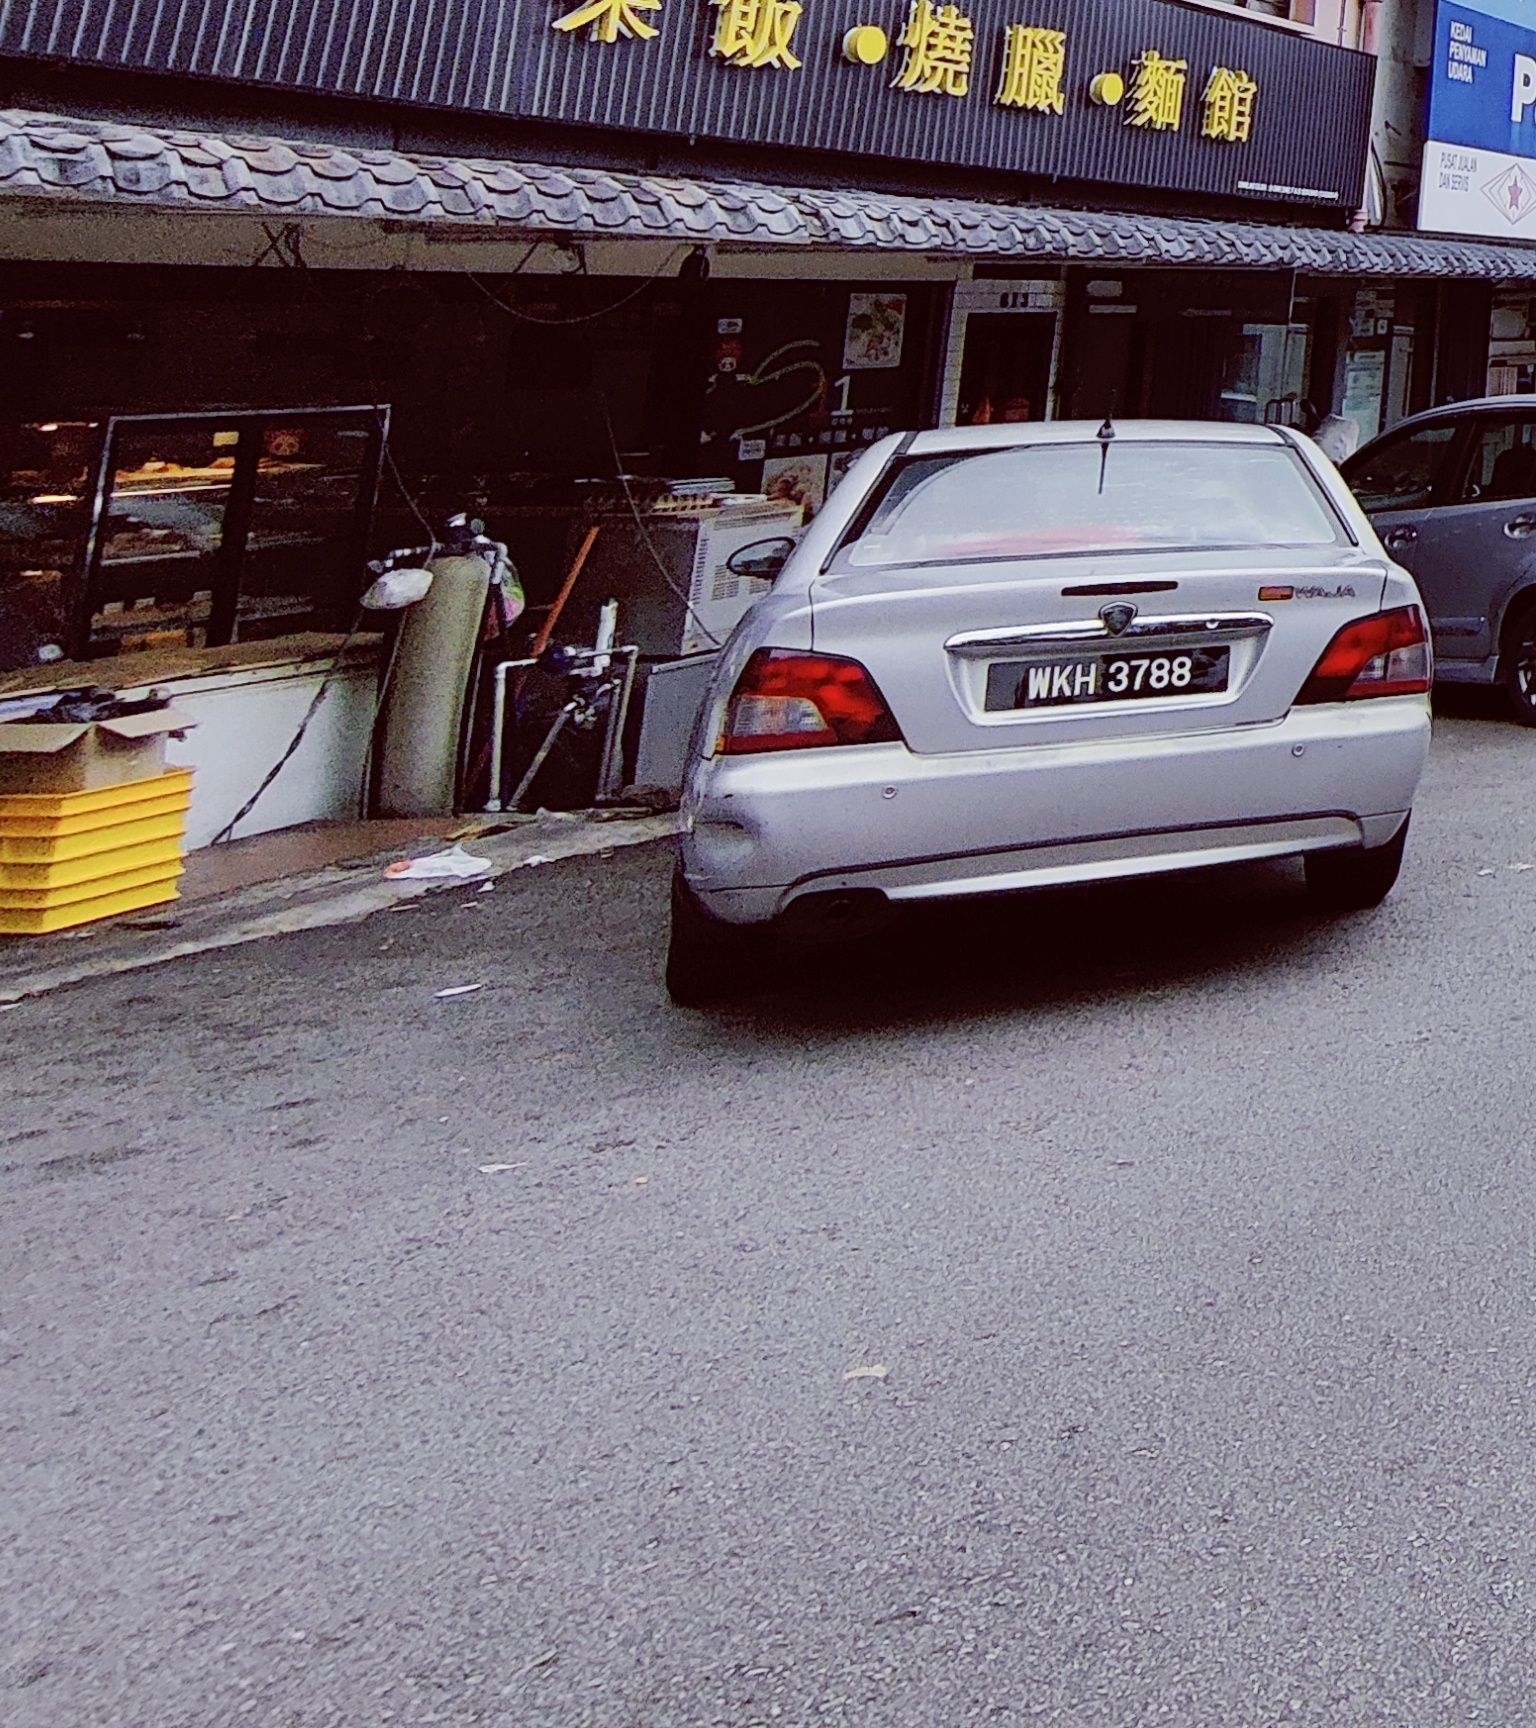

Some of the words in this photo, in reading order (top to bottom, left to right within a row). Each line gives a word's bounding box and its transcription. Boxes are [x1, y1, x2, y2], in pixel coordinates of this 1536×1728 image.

[1450, 20, 1473, 43] KEDAI
[1449, 41, 1487, 68] PENYAMAN
[1447, 61, 1474, 84] UDARA
[1027, 663, 1097, 701] WKH
[1108, 656, 1193, 693] 3788
